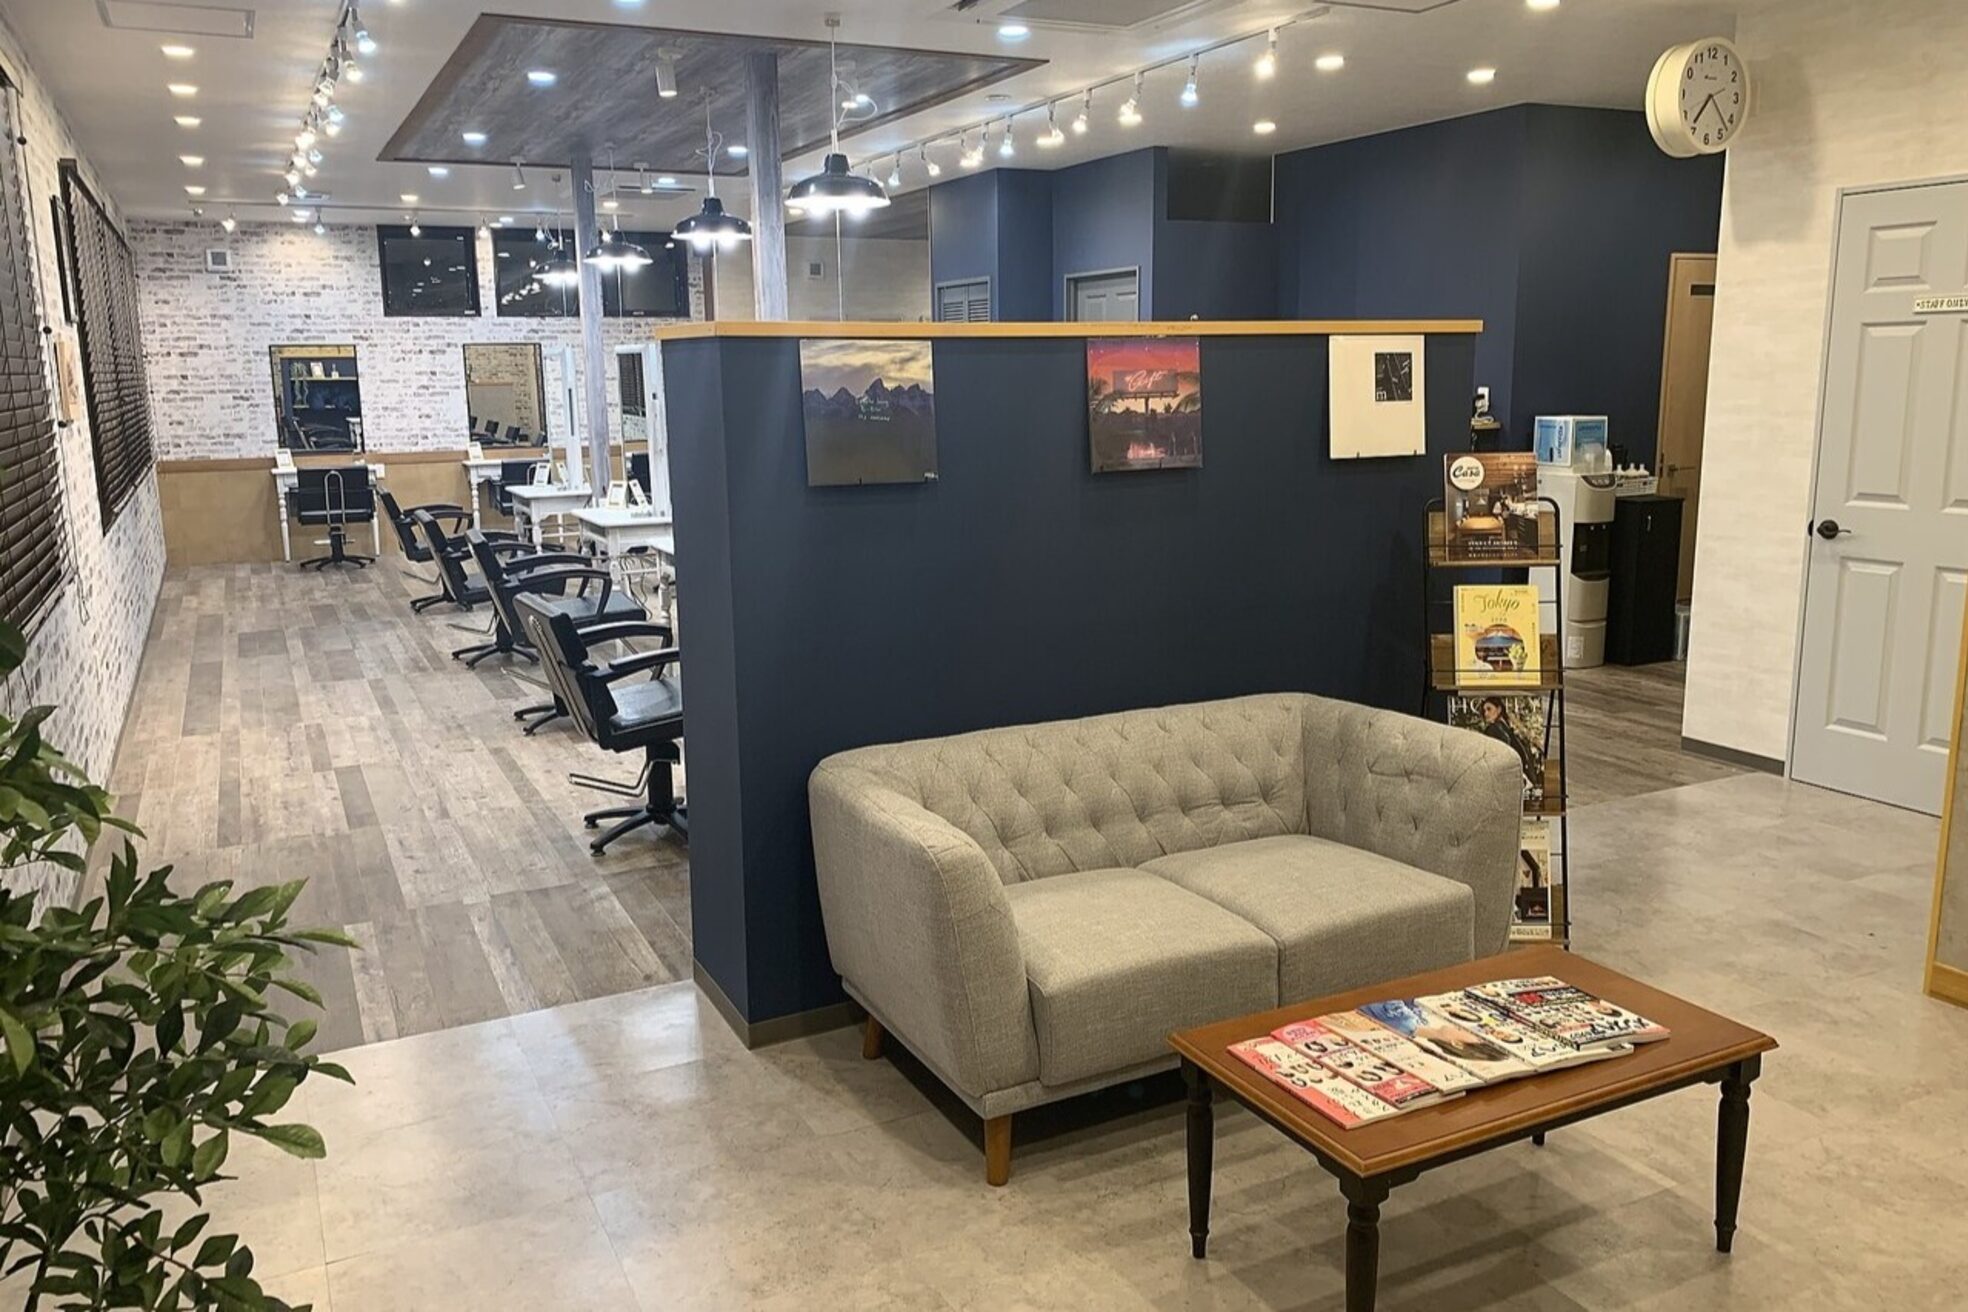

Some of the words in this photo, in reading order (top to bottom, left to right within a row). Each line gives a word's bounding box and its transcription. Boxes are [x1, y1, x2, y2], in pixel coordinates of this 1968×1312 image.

[1694, 52, 1704, 63] 11
[1707, 47, 1718, 60] 12
[1723, 55, 1729, 65] 1
[1731, 70, 1738, 83] 2
[1733, 92, 1739, 104] 3
[1727, 113, 1734, 125] 4
[1703, 132, 1710, 145] 6
[1717, 129, 1724, 140] 5
[1920, 298, 1945, 309] STAFF
[1452, 465, 1481, 479] Casa
[1473, 588, 1520, 613] Tokyo
